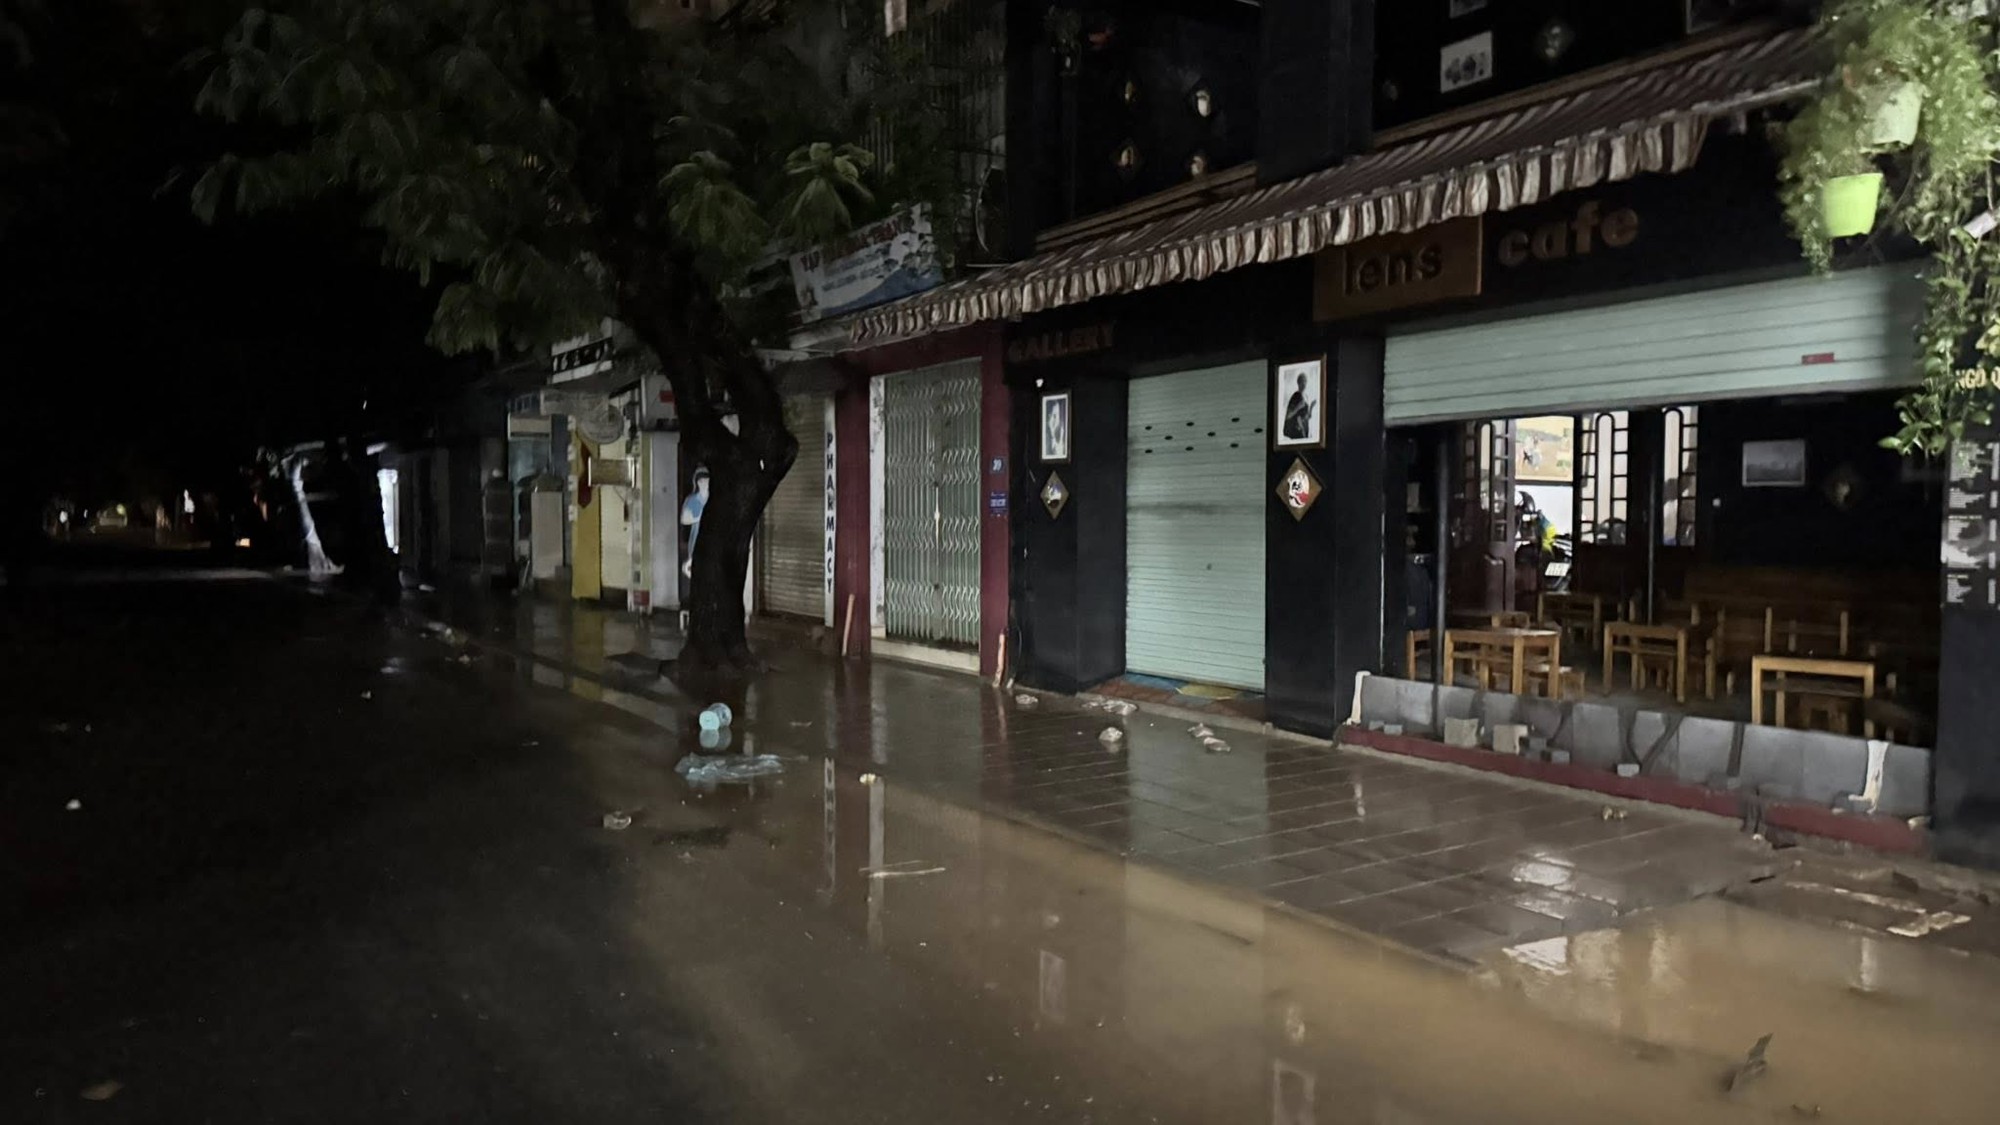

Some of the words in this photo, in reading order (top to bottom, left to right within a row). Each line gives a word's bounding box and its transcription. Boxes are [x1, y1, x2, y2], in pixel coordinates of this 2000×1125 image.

[1344, 243, 1442, 295] lens
[1498, 201, 1638, 267] cafe
[826, 433, 834, 593] PHARMACY
